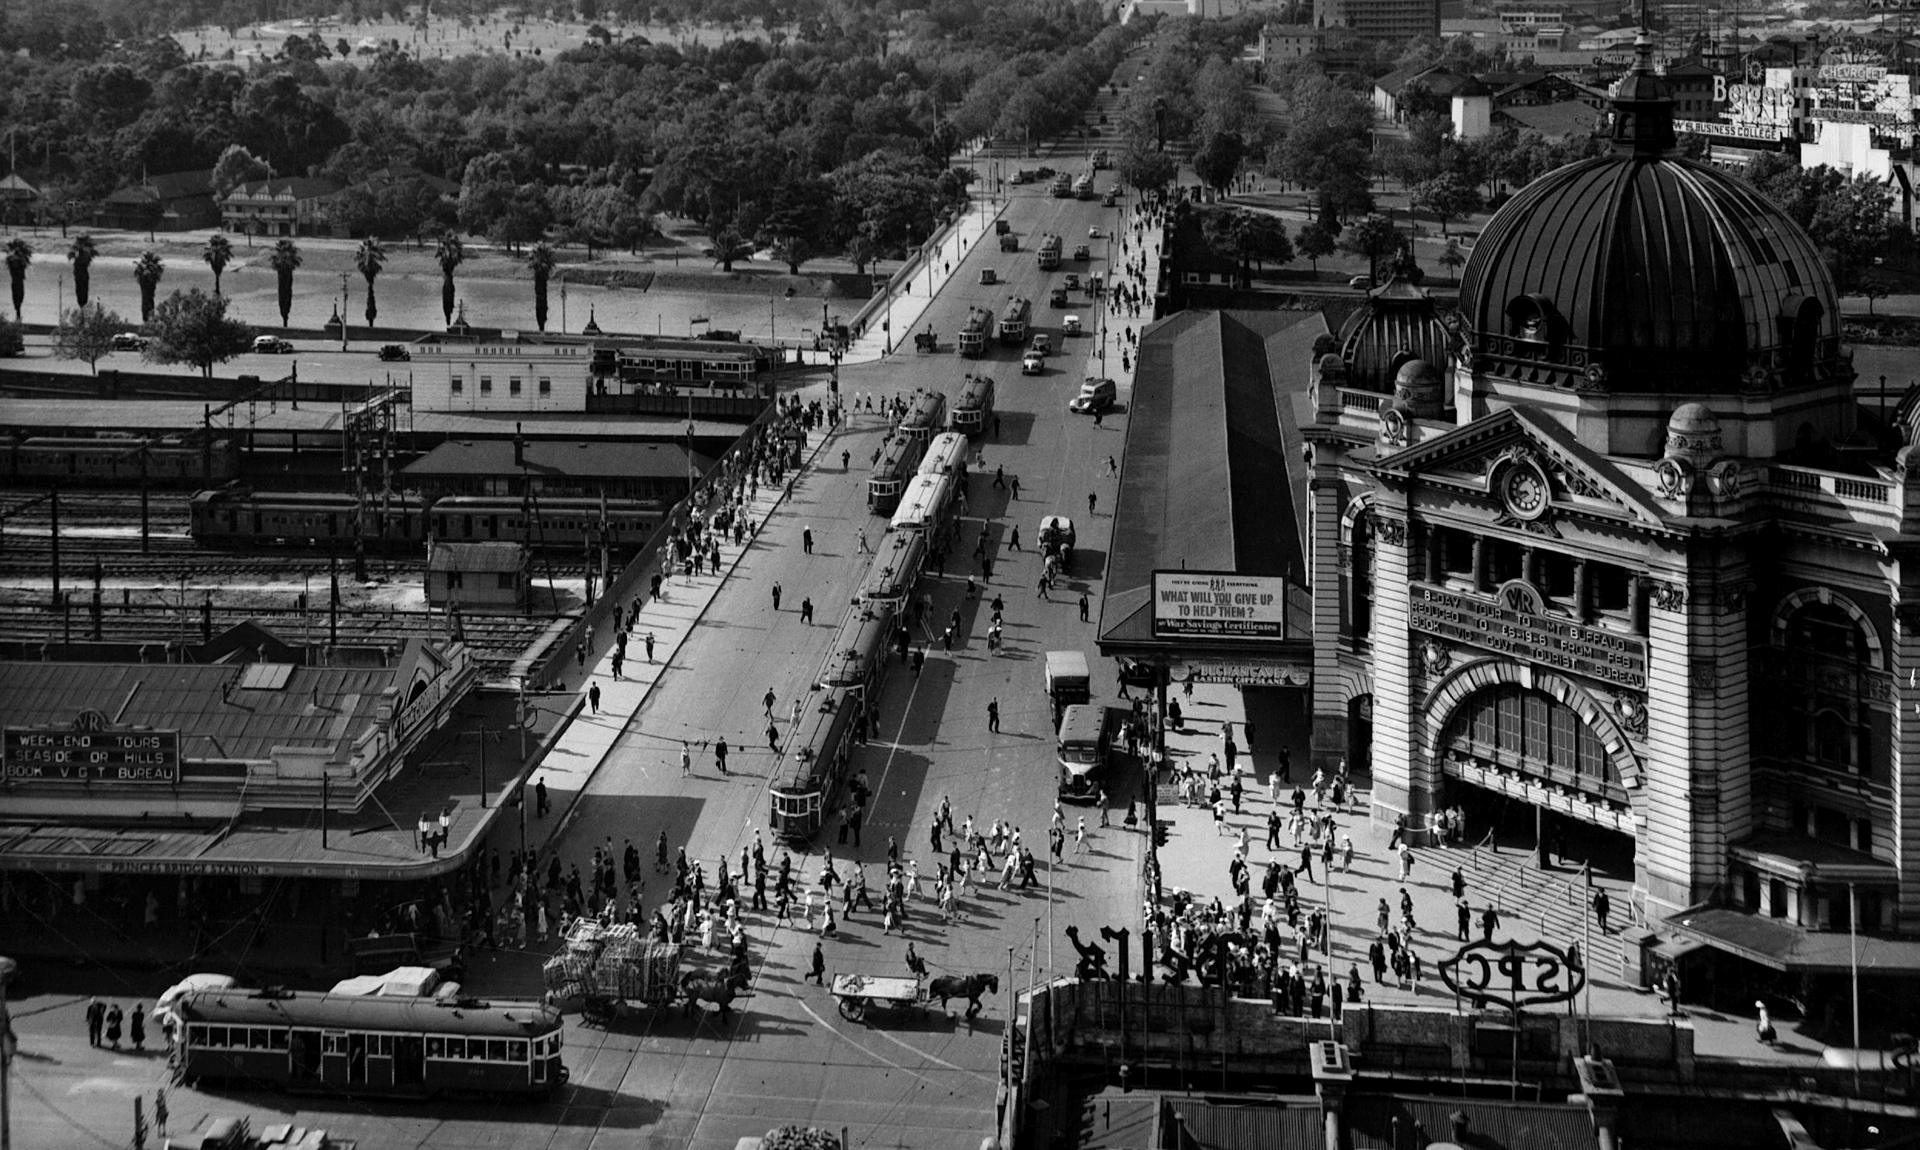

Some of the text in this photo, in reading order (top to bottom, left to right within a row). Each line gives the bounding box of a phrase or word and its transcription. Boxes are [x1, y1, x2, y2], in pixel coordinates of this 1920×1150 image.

[1822, 65, 1884, 80] CHEVROLET
[1713, 75, 1796, 107] Berger's
[1695, 122, 1736, 135] BUSINESS
[1737, 127, 1777, 140] COLLEGE
[1161, 591, 1274, 606] WHAT WILL YOU GIVE UP
[1506, 588, 1535, 614] VR
[1178, 605, 1190, 616] TO
[1193, 606, 1216, 617] HELP
[1219, 607, 1245, 618] THEM
[1166, 619, 1186, 629] War
[1187, 620, 1222, 630] Savings
[1224, 621, 1278, 631] Certificates
[1424, 590, 1626, 652] 8-DAY TOUR TO MT BUFFALO
[1412, 602, 1460, 623] REDUCED
[1474, 616, 1488, 631] TO
[1560, 640, 1594, 658] FROM
[1607, 653, 1632, 668] FEB
[1411, 616, 1645, 688] BOOK VIC GOVT TOURIST BUREAU
[77, 714, 100, 731] VR
[19, 735, 161, 749] WEEK-END TOURS
[15, 750, 165, 764] SEASIDE OR HILLS
[6, 765, 174, 779] BOOK V G T BUREAU
[111, 861, 260, 875] PRINCES BRIDGE STATION
